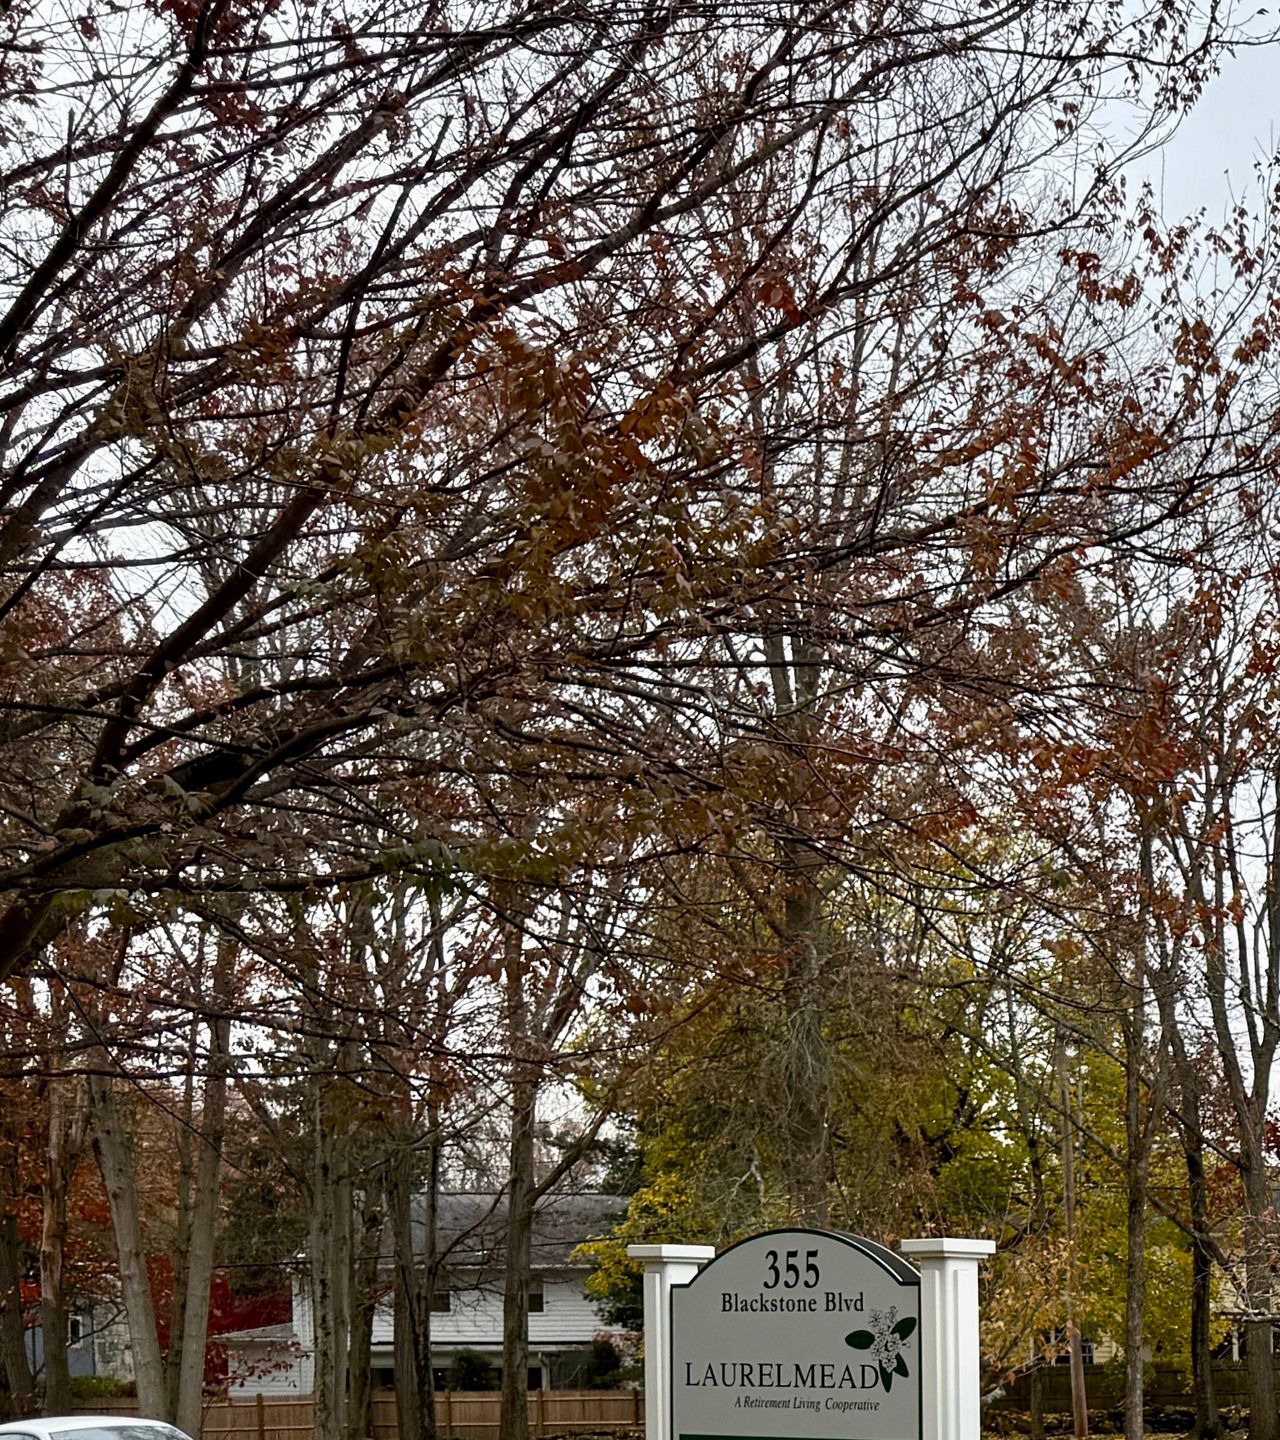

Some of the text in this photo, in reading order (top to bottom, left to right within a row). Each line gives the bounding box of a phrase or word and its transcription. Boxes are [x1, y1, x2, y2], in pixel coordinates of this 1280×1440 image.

[763, 1250, 820, 1288] 355
[721, 1292, 864, 1312] Blackstone Blvd
[685, 1362, 879, 1389] LAURELMEAD
[734, 1397, 880, 1412] A Retirement Living Cooperative
